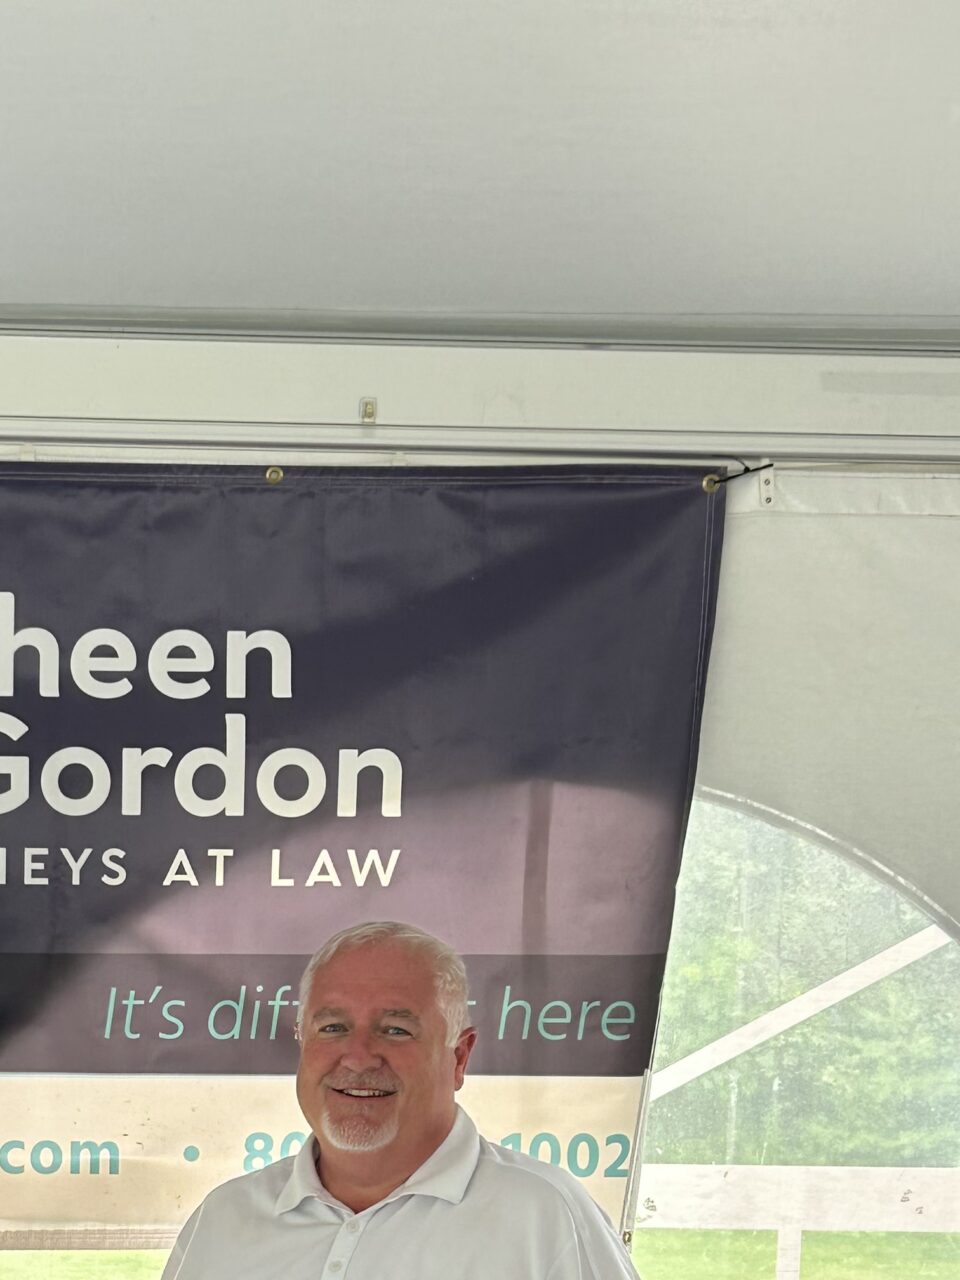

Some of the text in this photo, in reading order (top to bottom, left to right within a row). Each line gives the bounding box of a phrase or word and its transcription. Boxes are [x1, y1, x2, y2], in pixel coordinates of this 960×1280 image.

[162, 849, 235, 887] AT
[270, 848, 402, 888] LAW
[103, 985, 187, 1041] It's
[498, 985, 637, 1042] here
